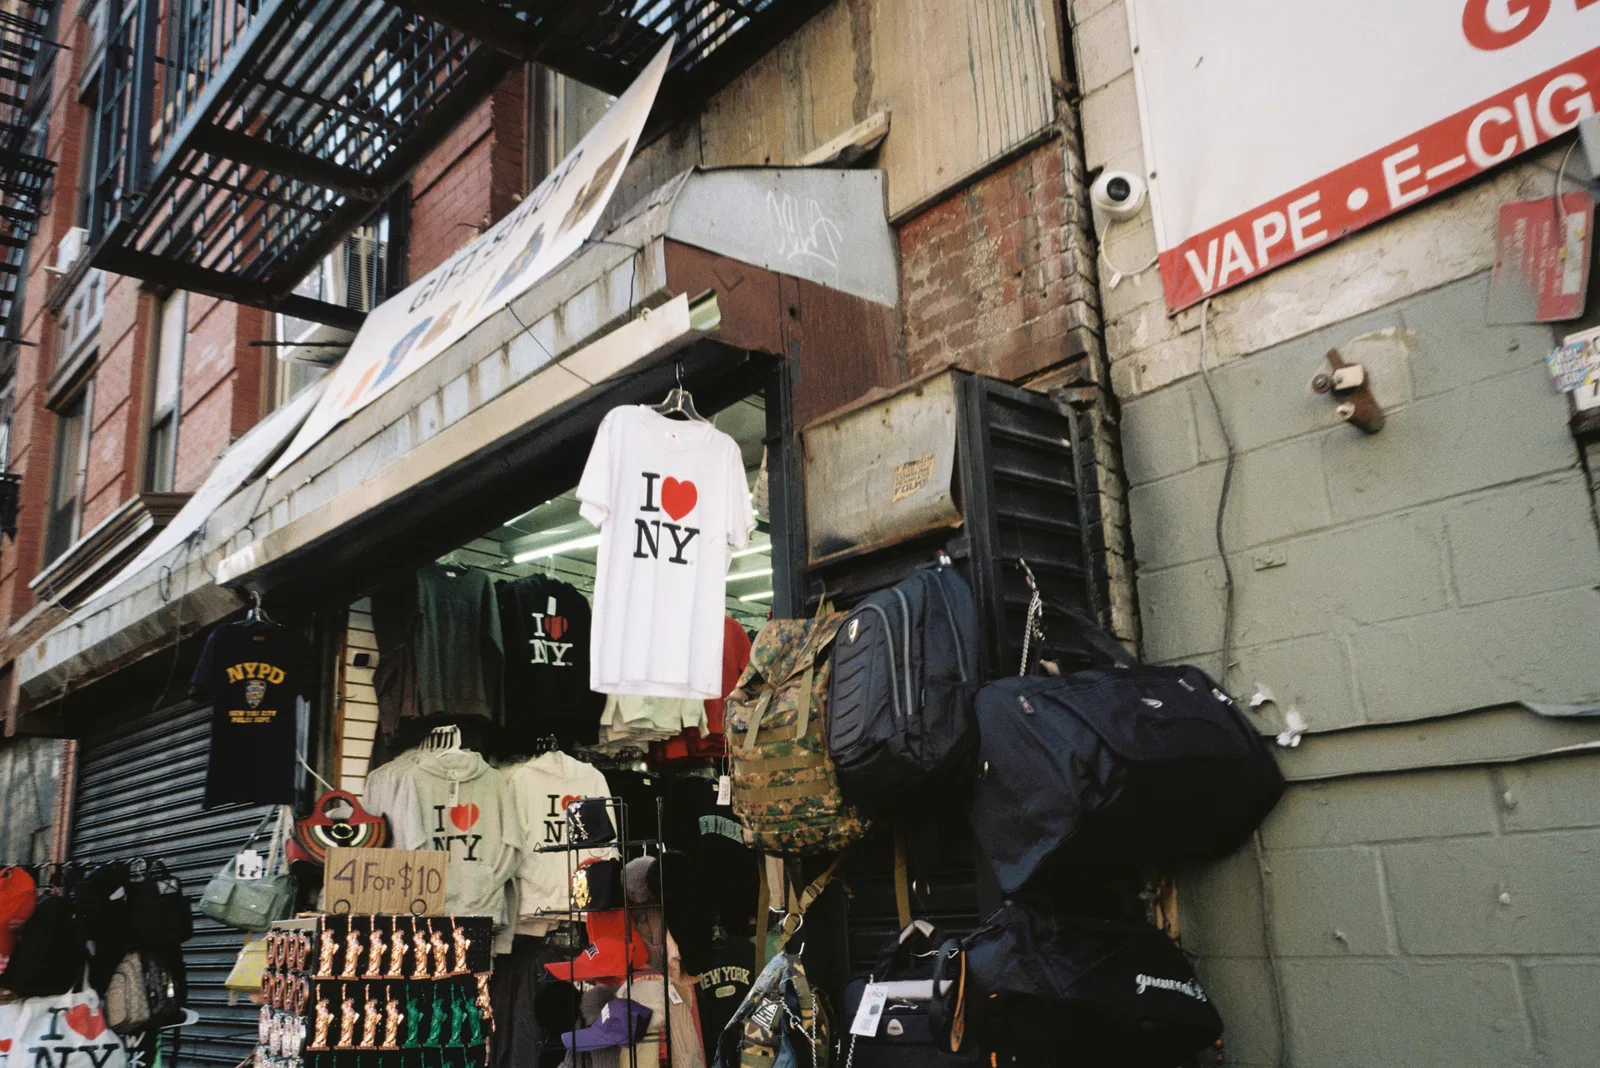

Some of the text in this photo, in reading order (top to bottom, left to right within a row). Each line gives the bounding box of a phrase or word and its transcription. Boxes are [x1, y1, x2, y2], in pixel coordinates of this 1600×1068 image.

[1462, 0, 1600, 51] G
[408, 239, 489, 314] GIFT
[484, 149, 584, 258] SHOP
[1186, 191, 1328, 293] VAPE
[640, 472, 661, 512] I
[633, 518, 700, 565] NY
[532, 612, 546, 637] I
[529, 639, 573, 666] NY
[226, 662, 287, 685] NYPD
[433, 805, 445, 832] I
[548, 794, 560, 817] I
[544, 820, 566, 843] N
[432, 834, 482, 861] NY
[333, 858, 357, 895] 4
[398, 861, 442, 897] $10
[722, 965, 750, 985] YORK
[41, 1007, 69, 1040] I
[29, 1043, 120, 1068] NY
